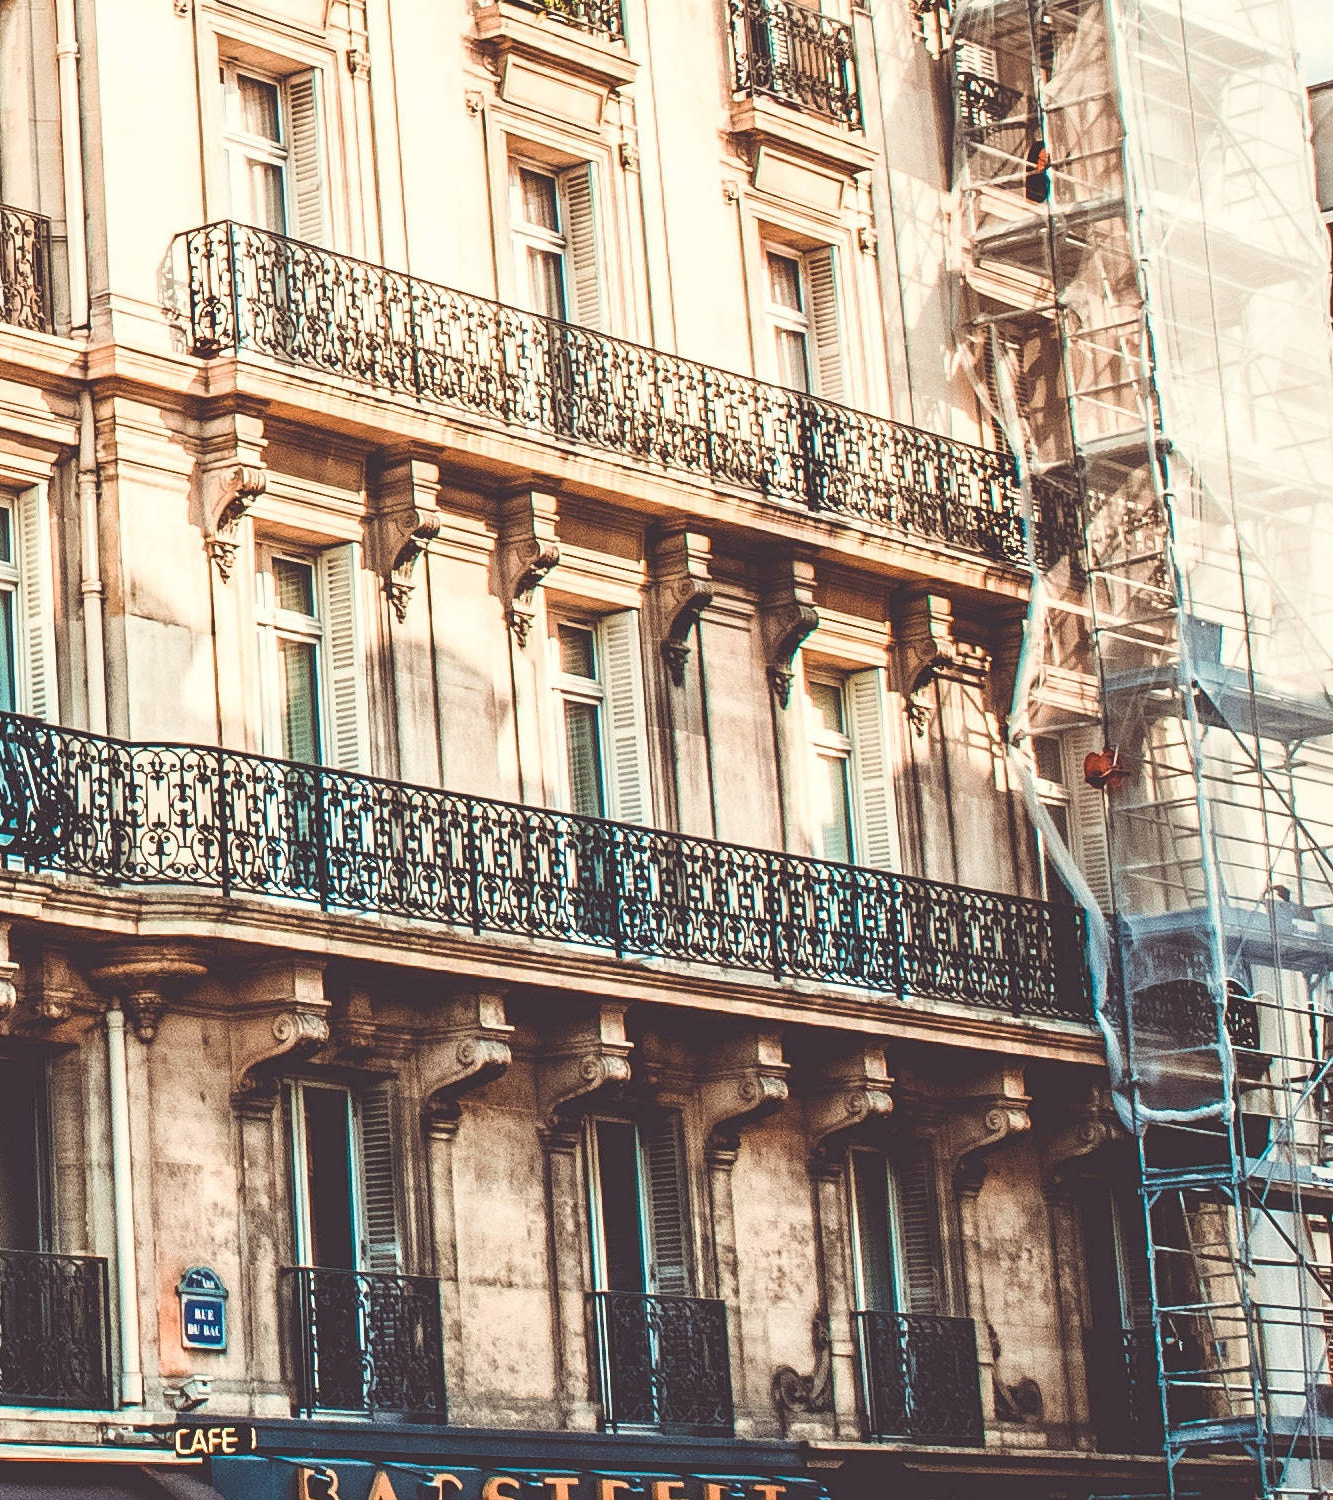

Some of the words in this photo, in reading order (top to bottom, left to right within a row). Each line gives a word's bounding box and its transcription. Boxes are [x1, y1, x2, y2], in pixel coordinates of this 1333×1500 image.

[195, 1308, 214, 1320] RUE
[188, 1323, 200, 1335] DU
[175, 1428, 238, 1455] CAFE
